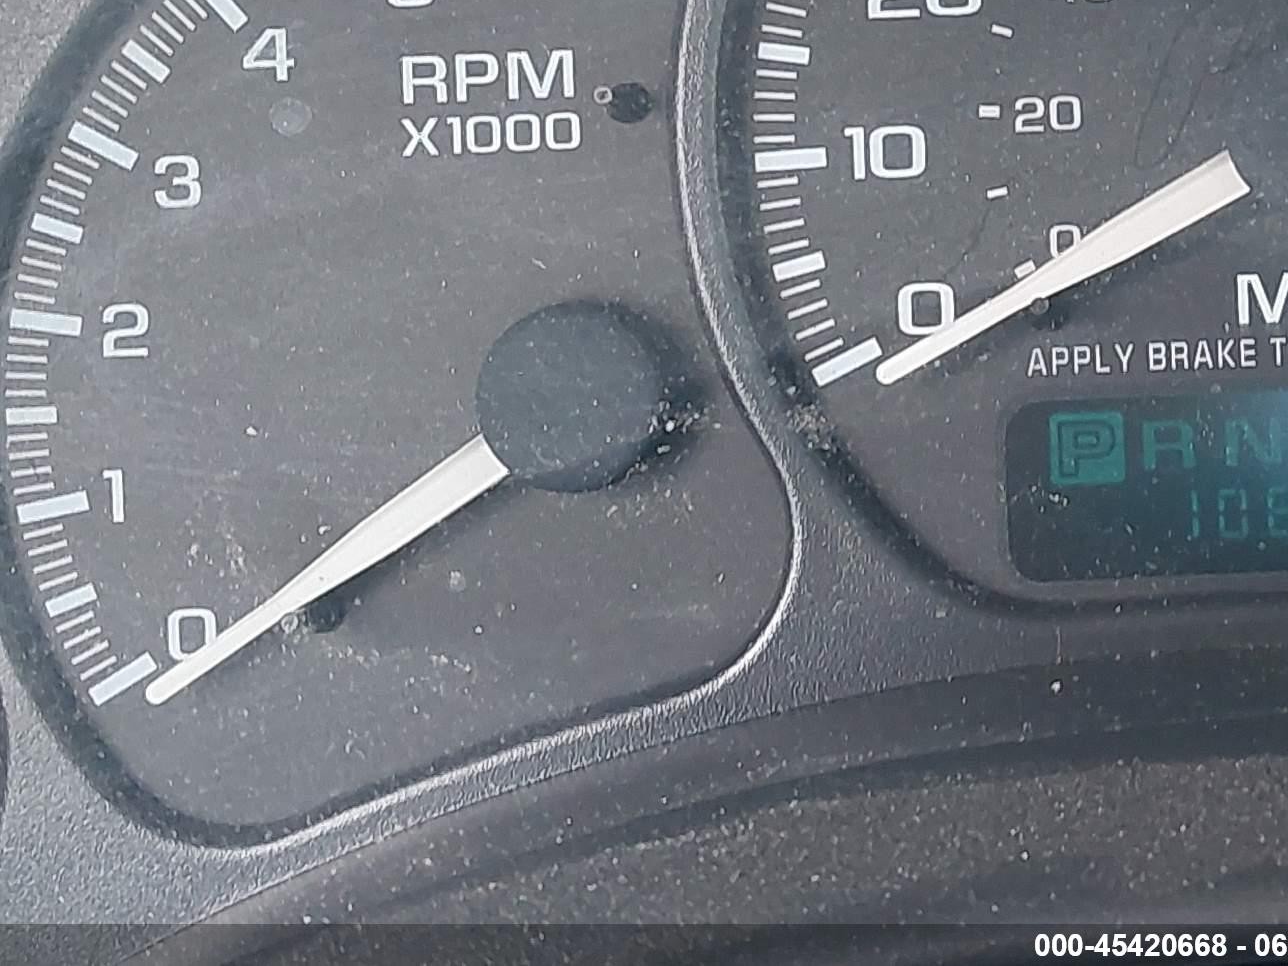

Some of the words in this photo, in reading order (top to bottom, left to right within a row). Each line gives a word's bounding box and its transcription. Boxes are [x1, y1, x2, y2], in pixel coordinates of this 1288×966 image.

[242, 27, 295, 82] 4
[401, 49, 575, 104] RPM
[401, 112, 581, 157] X1000
[1014, 95, 1081, 133] 20
[843, 125, 926, 180] 10
[154, 155, 202, 209] 3
[1048, 223, 1083, 259] 0
[102, 303, 149, 358] 2
[897, 280, 957, 337] 0
[1027, 343, 1134, 377] APPLY
[1148, 338, 1257, 371] BRAKE
[1055, 418, 1117, 479] P
[1143, 422, 1195, 471] R
[1224, 419, 1281, 468] N
[102, 469, 125, 523] 1
[166, 608, 218, 661] 0
